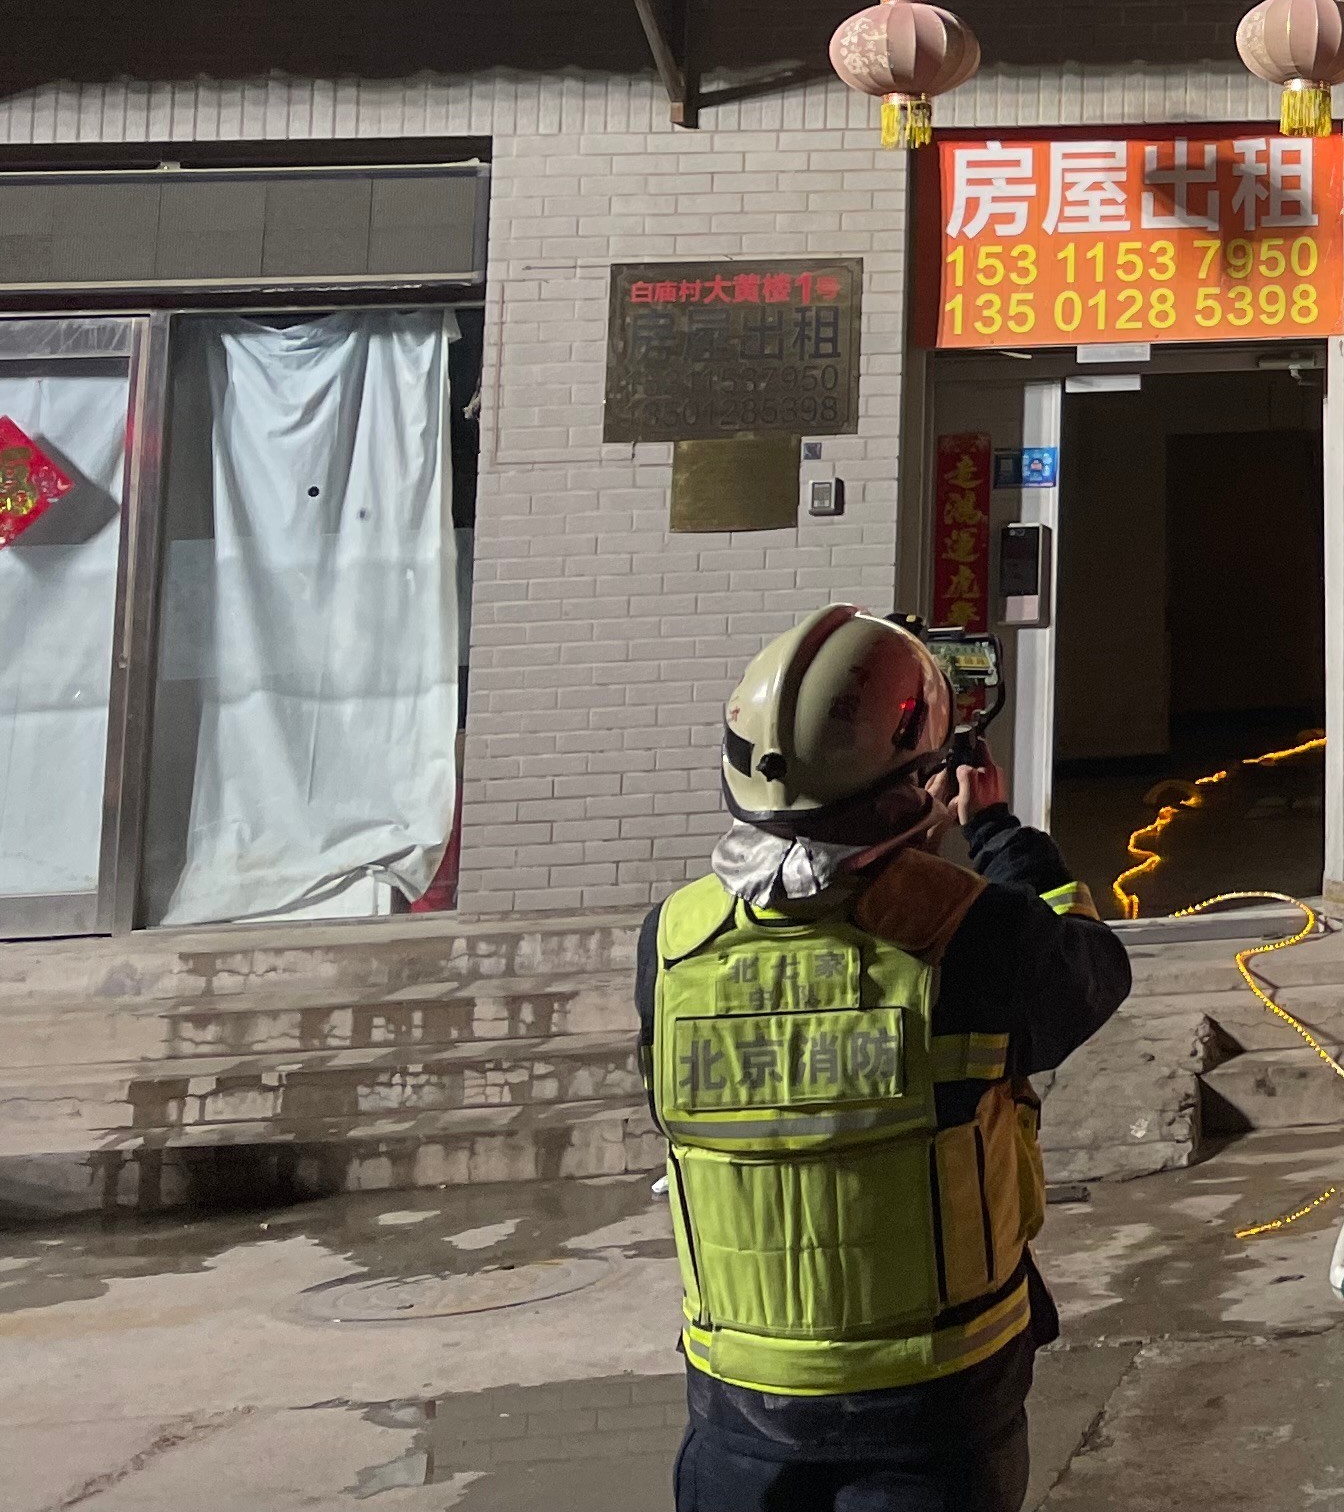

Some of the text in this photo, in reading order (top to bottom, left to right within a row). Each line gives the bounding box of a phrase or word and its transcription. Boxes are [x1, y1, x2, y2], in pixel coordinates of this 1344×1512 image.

[945, 136, 1320, 239] 房屋出租
[945, 236, 1320, 288] 153 1153 7950
[630, 305, 842, 361] 房屋出租
[944, 283, 1320, 336] 135 0128 5398
[678, 1026, 899, 1093] 北京消防
